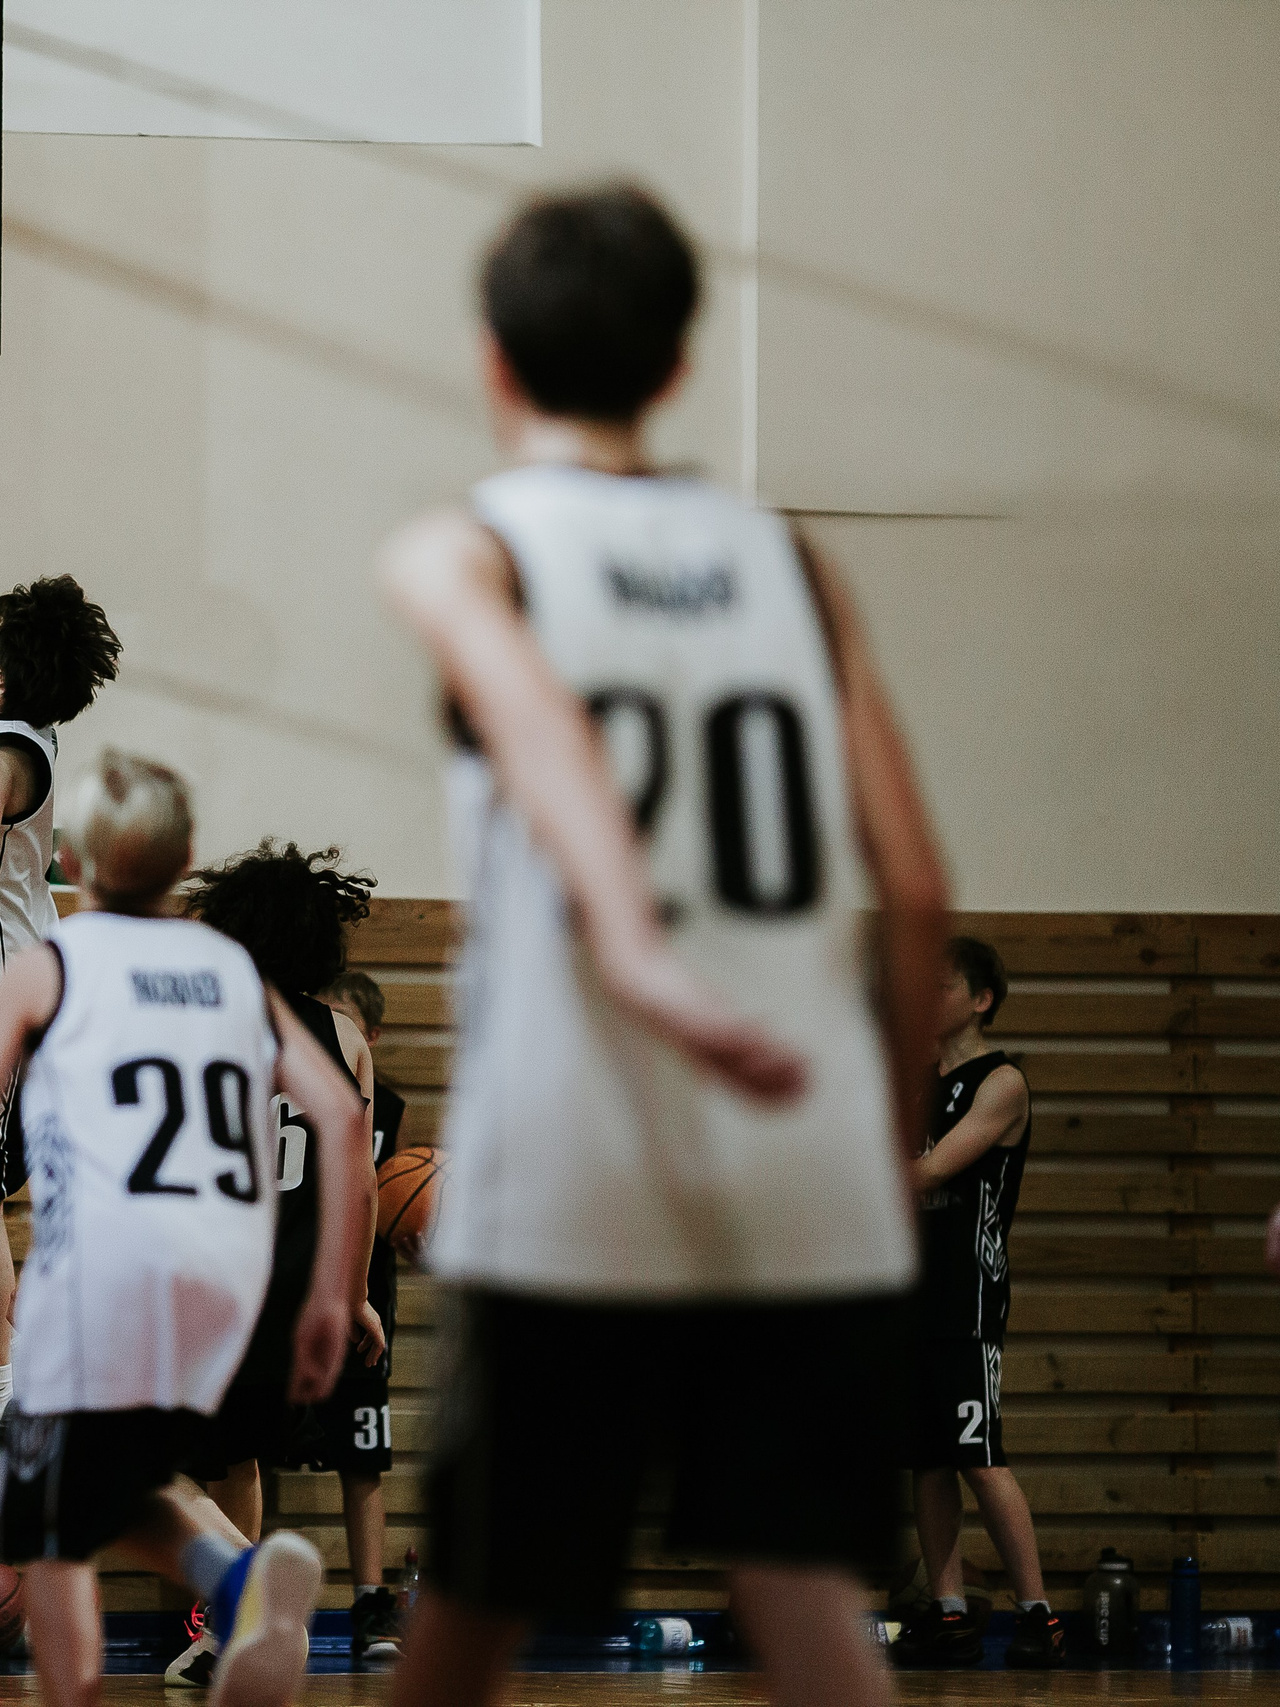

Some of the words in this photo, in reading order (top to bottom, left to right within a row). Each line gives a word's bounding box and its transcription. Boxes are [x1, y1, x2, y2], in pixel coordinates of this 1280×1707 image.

[111, 1057, 258, 1203] 29
[353, 1405, 392, 1450] 31
[957, 1400, 983, 1444] 2
